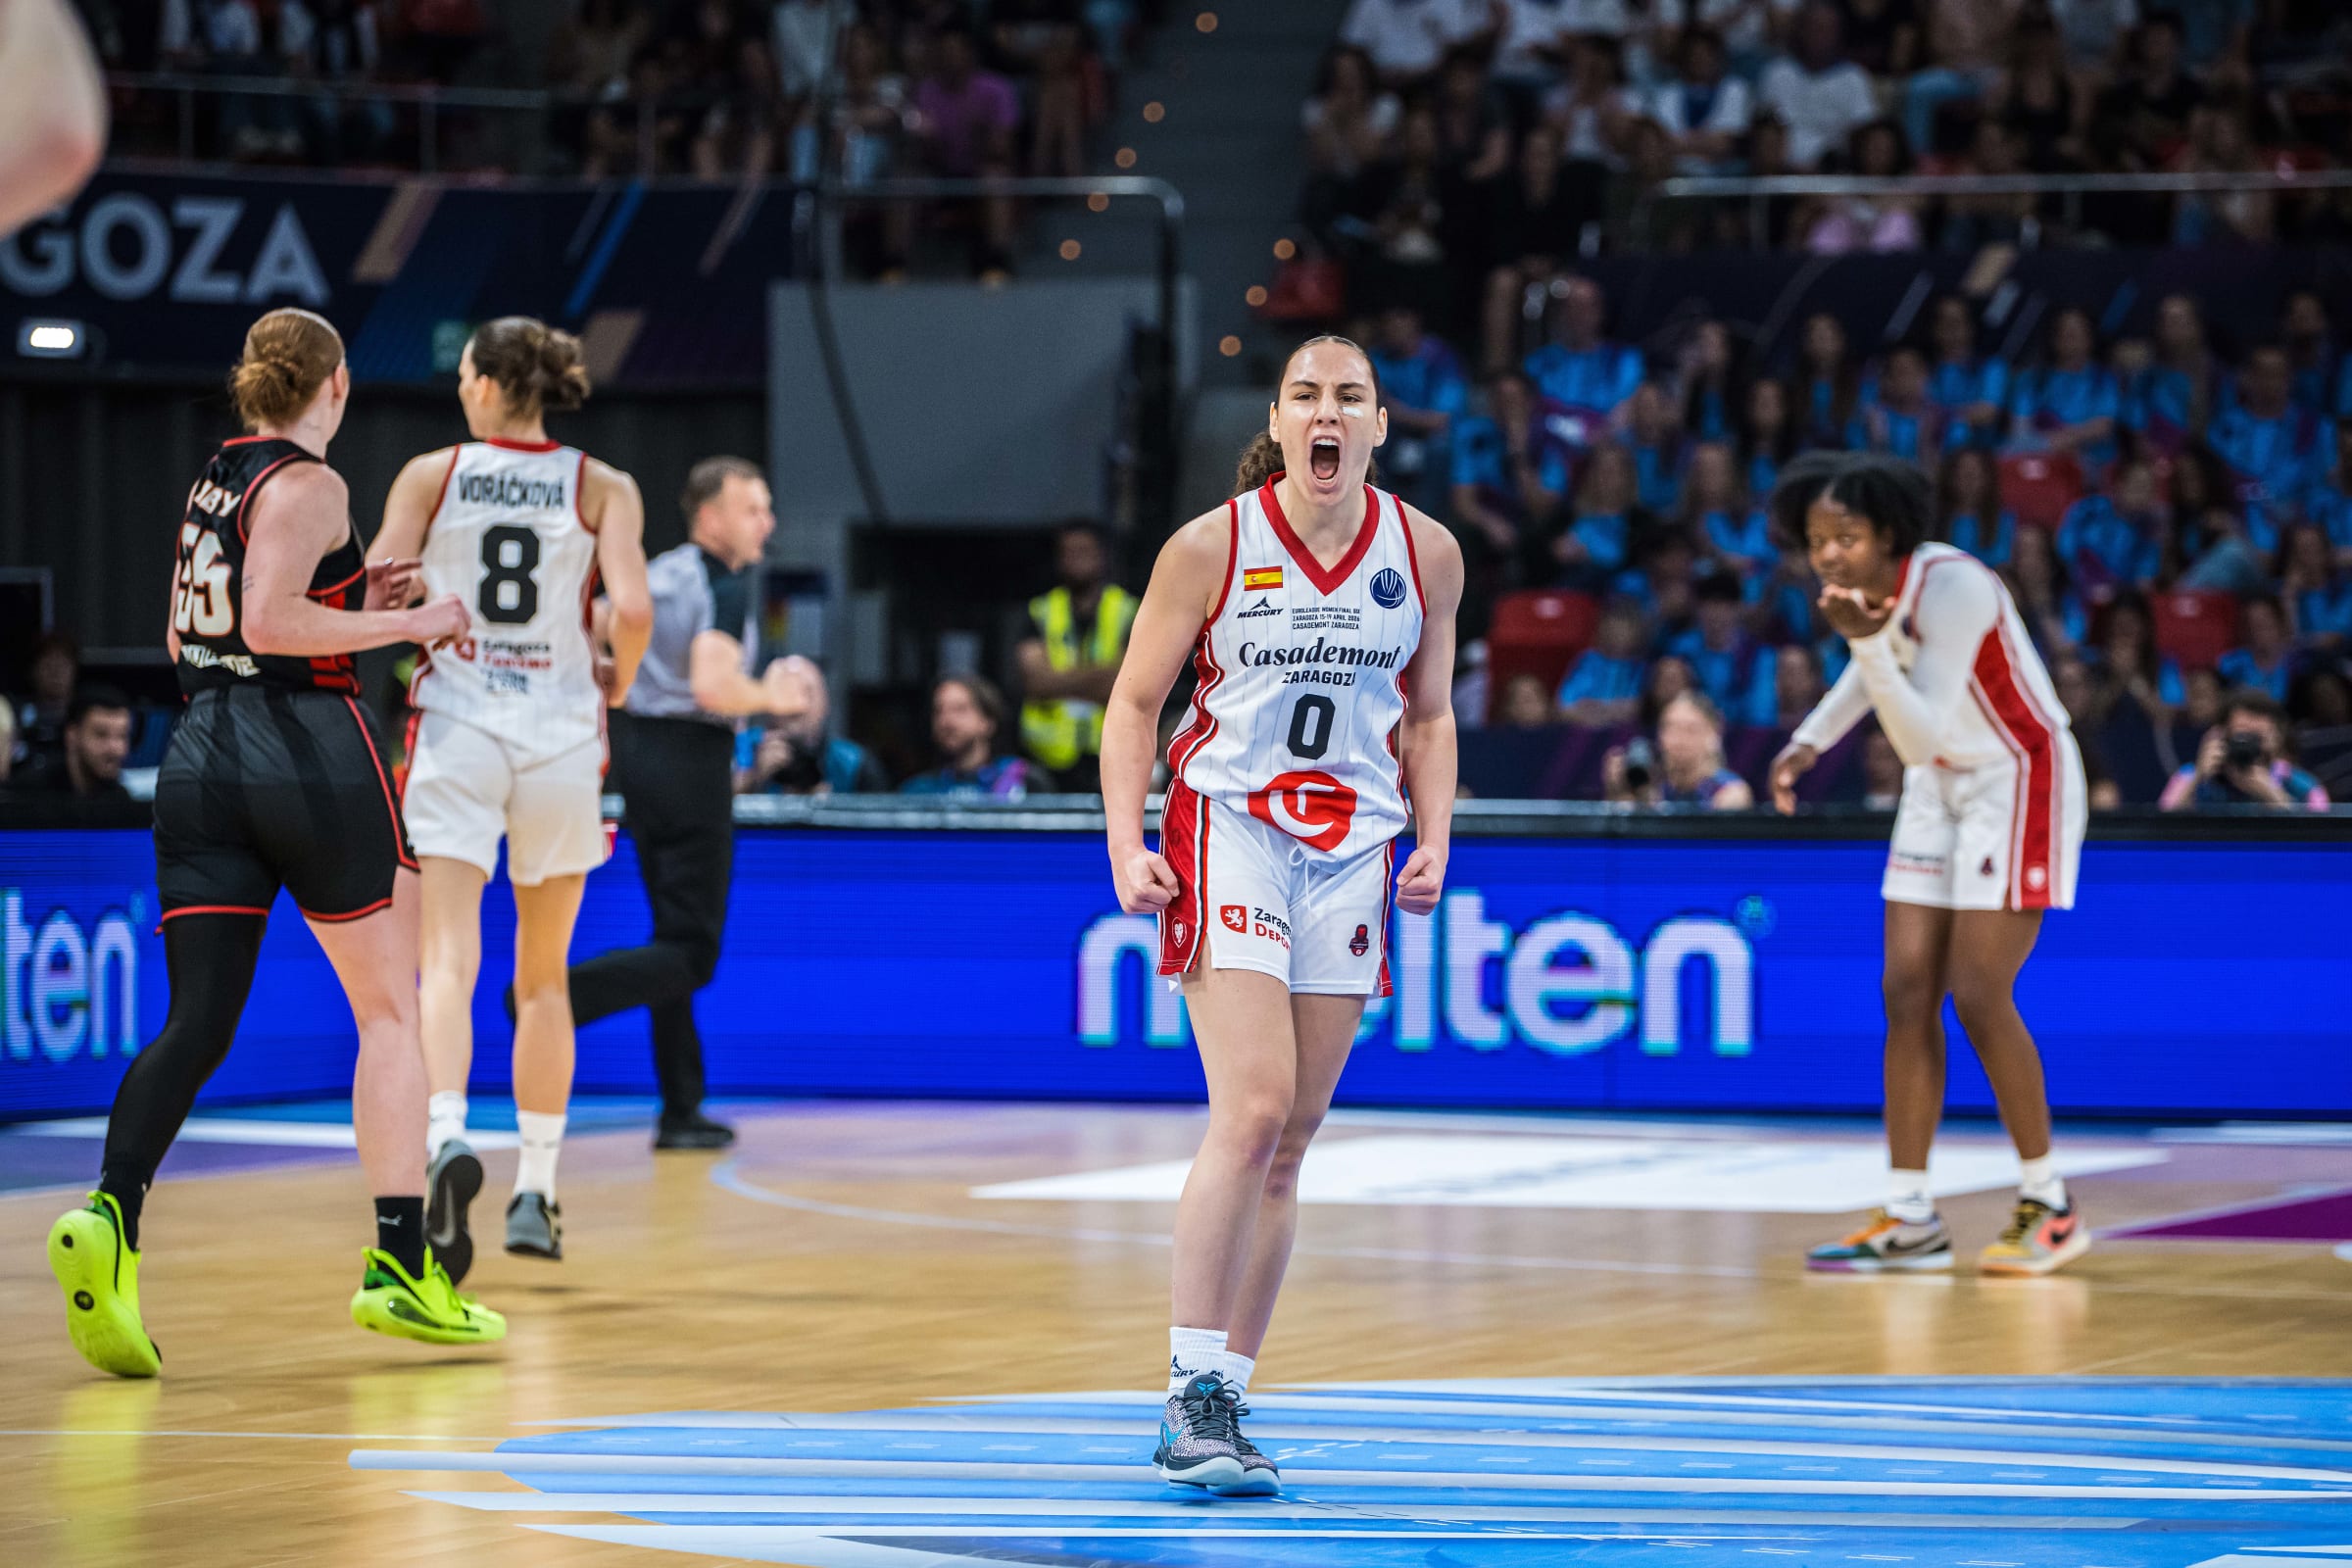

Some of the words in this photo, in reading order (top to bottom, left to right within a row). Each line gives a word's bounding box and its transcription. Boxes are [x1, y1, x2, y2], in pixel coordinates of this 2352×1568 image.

[459, 471, 565, 508] VORÁČKOVÁ
[479, 525, 540, 624] 8
[1237, 608, 1285, 619] MERCURY
[1292, 621, 1330, 630] CASADEMONT
[1239, 637, 1401, 669] Casademont
[1287, 694, 1336, 760] 0
